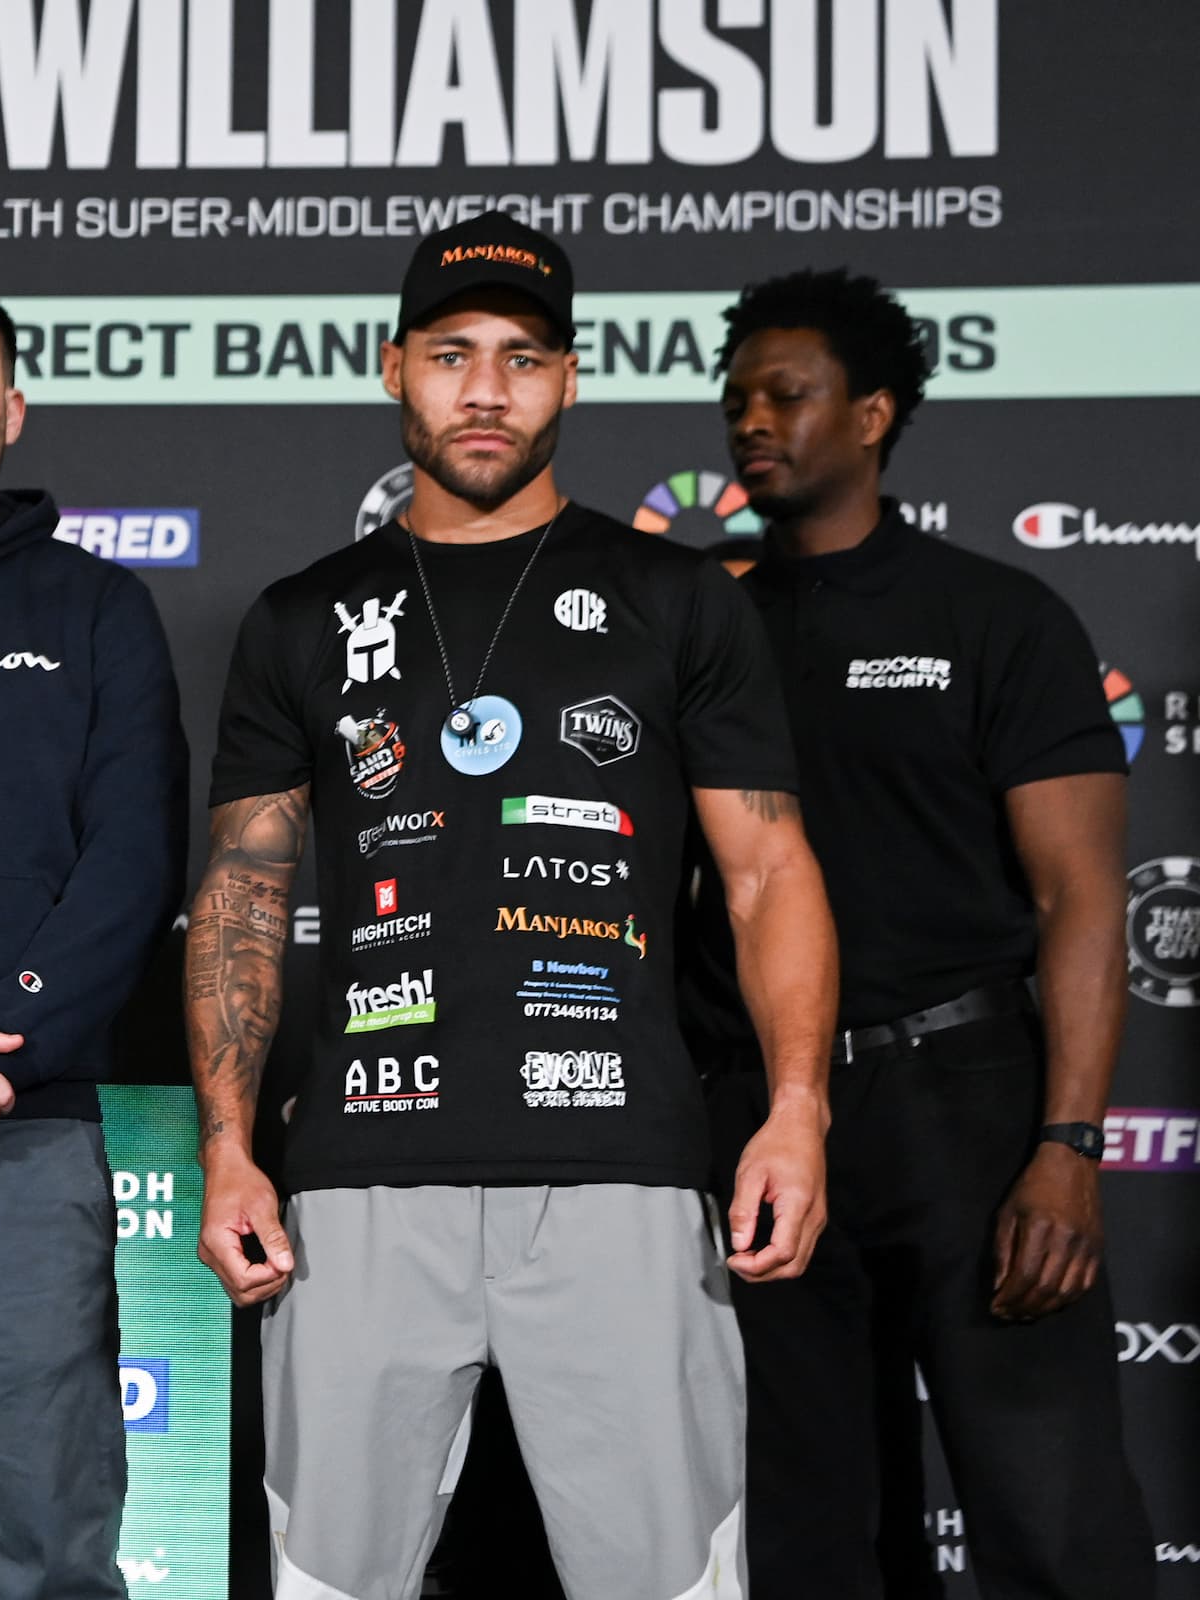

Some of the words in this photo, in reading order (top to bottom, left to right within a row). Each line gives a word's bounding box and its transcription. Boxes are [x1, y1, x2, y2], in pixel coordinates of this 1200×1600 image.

[603, 186, 1002, 235] CHAMPIONSHIPS
[14, 321, 191, 379] RECT
[845, 673, 951, 691] SECURITY
[847, 656, 951, 678] BOXXER
[570, 712, 633, 752] TWINS
[531, 802, 617, 825] strati
[352, 911, 432, 945] HIGHTECH
[494, 906, 620, 940] MANJAROS
[531, 959, 545, 972] B
[346, 968, 435, 1017] fresh!
[524, 1002, 618, 1021] 07734451134
[522, 1051, 625, 1090] EVOLVE
[344, 1100, 381, 1113] ACTIVE
[383, 1099, 414, 1112] BODY
[416, 1097, 439, 1110] CON
